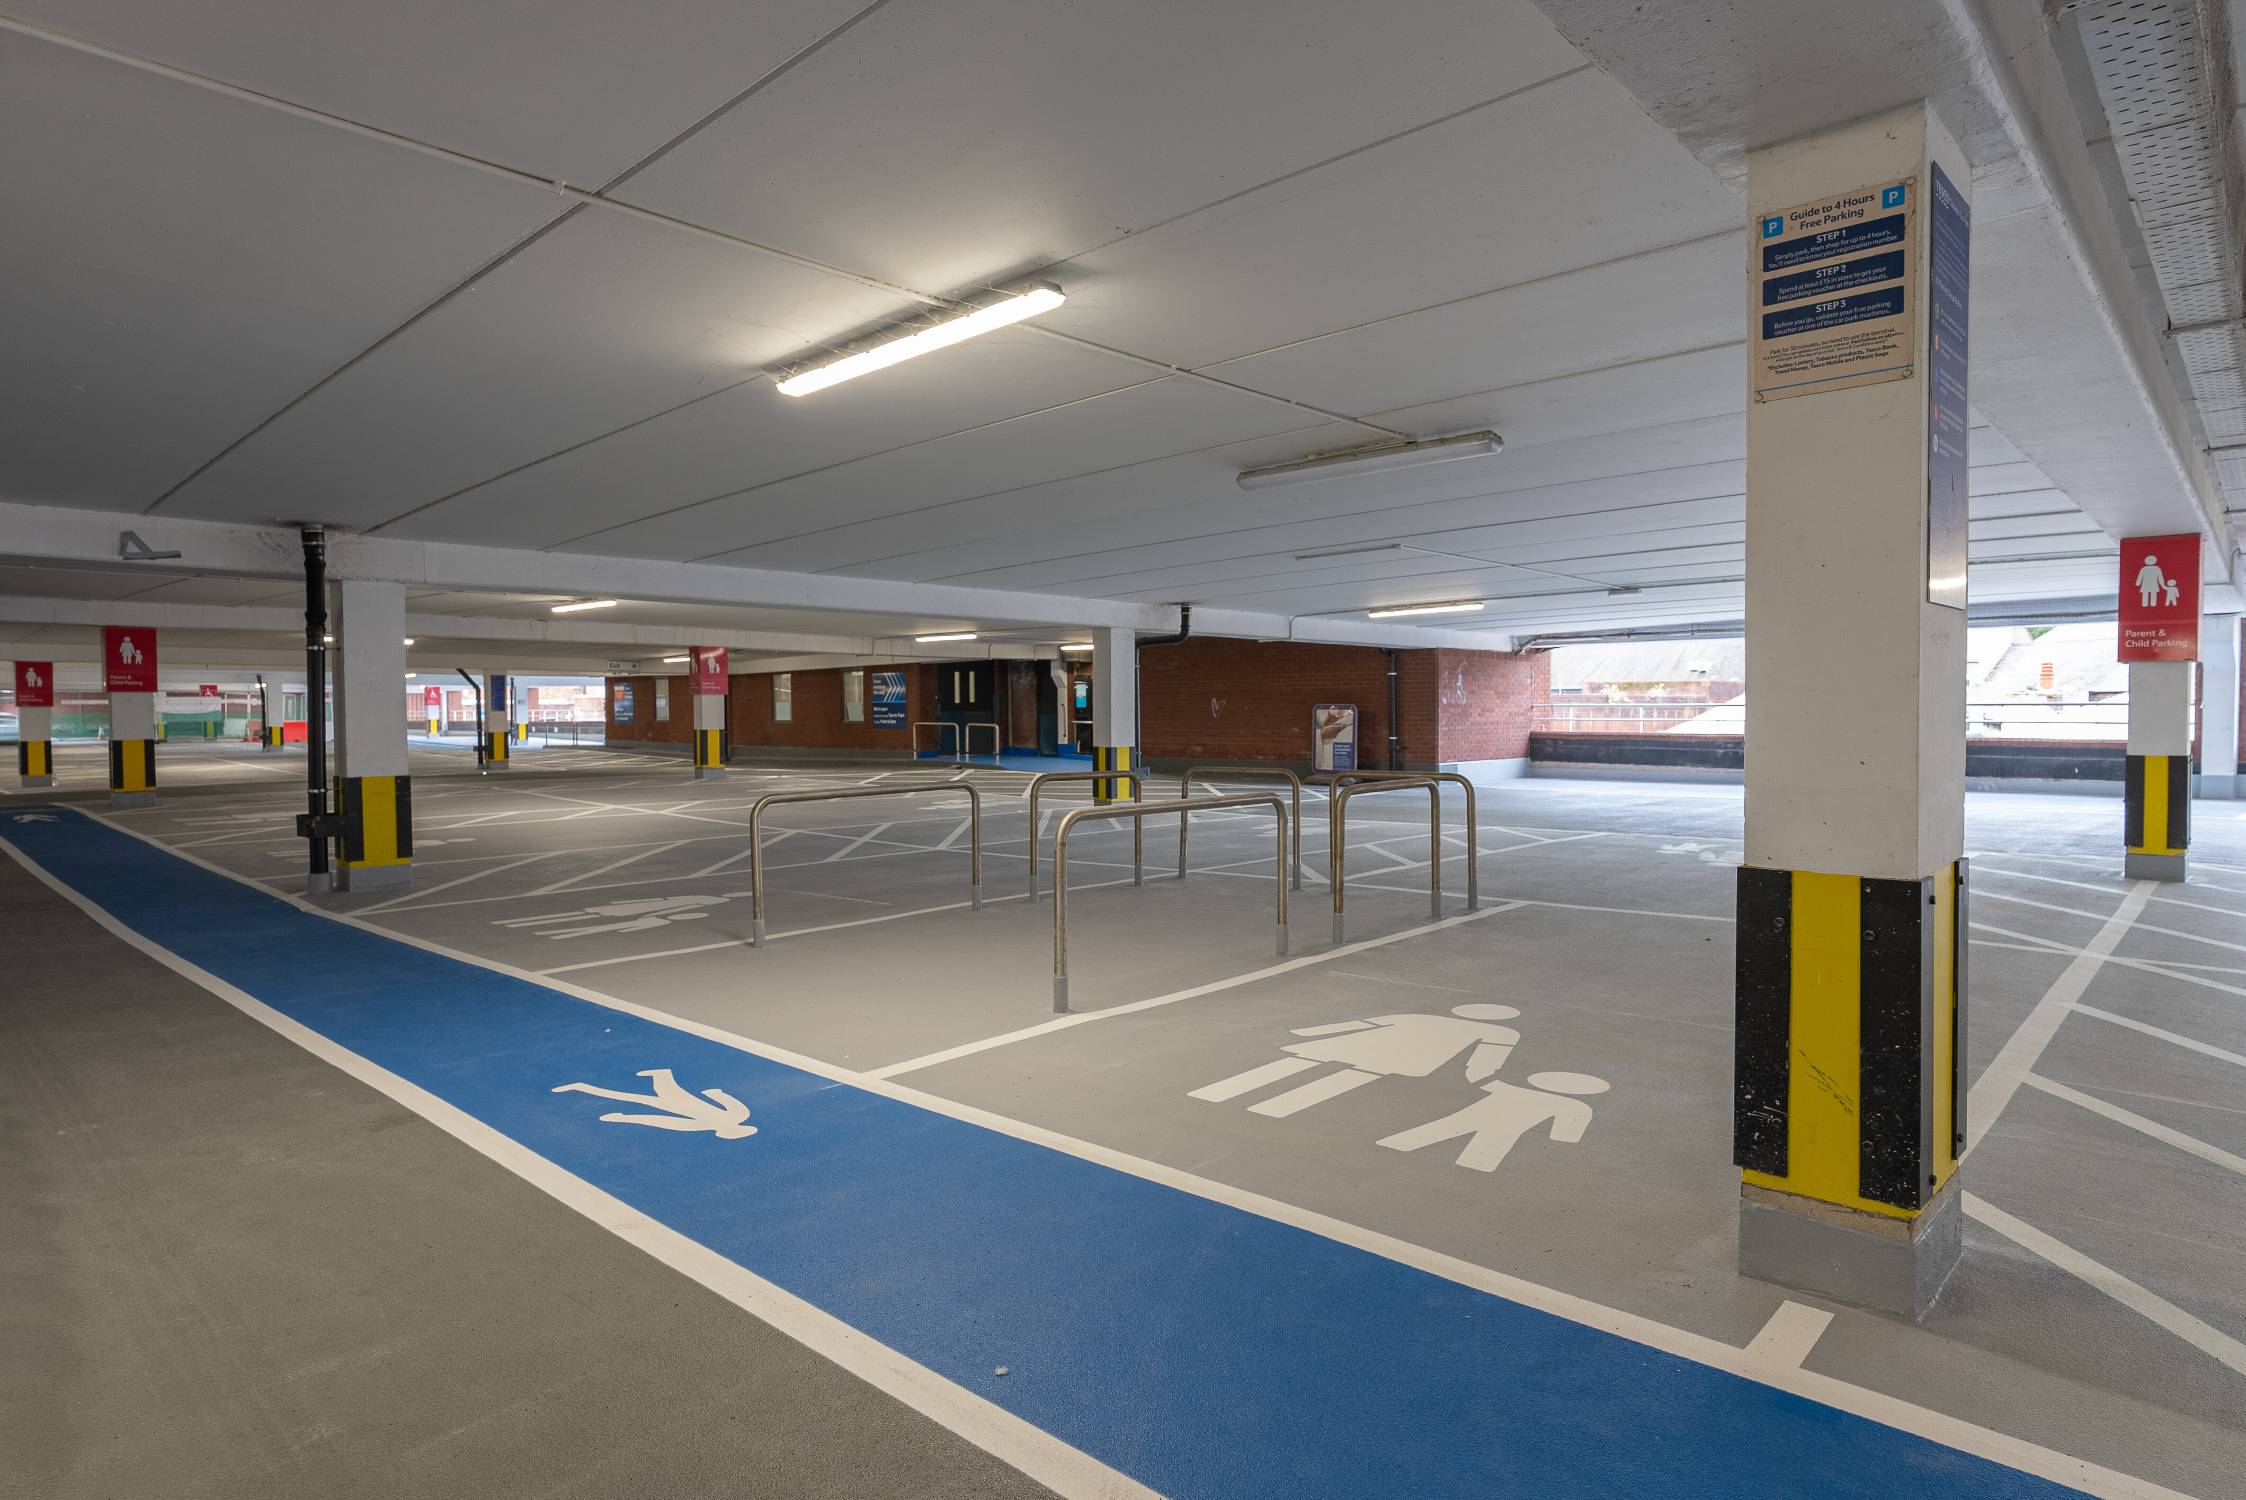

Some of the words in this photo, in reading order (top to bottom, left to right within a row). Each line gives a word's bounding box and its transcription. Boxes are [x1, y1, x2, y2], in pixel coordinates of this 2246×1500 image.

[1888, 191, 1898, 203] P
[1790, 207, 1819, 220] Guide
[1822, 205, 1832, 213] to
[1834, 200, 1841, 209] 4
[1843, 194, 1874, 207] Hours
[1800, 219, 1820, 229] Free
[1824, 208, 1863, 224] Parking
[1769, 221, 1776, 233] P
[1816, 231, 1839, 243] STEP
[1768, 260, 1784, 268] You'll
[1784, 257, 1798, 265] need
[1823, 249, 1836, 257] your
[1837, 241, 1871, 252] registration
[1775, 252, 1794, 261] Simply
[1795, 248, 1809, 256] park,
[1825, 241, 1839, 249] shop
[1816, 266, 1839, 277] STEP
[1841, 264, 1846, 272] 2
[1778, 285, 1797, 294] Spend
[1805, 280, 1818, 288] least
[1819, 277, 1829, 285] £15
[1838, 273, 1852, 281] store
[1861, 269, 1870, 277] get
[1872, 266, 1885, 275] your
[1789, 289, 1811, 299] parking
[1812, 283, 1835, 293] voucher
[1816, 301, 1839, 312] STEP
[1840, 299, 1845, 307] 3
[1774, 320, 1793, 328] Before
[1815, 312, 1838, 320] validate
[1839, 309, 1852, 317] your
[1867, 301, 1890, 310] parking
[1775, 326, 1796, 335] voucher
[1844, 314, 1858, 322] park
[2125, 629, 2156, 638] Parent
[2158, 628, 2167, 637] &
[2125, 639, 2150, 648] Child
[2152, 639, 2189, 649] Parking
